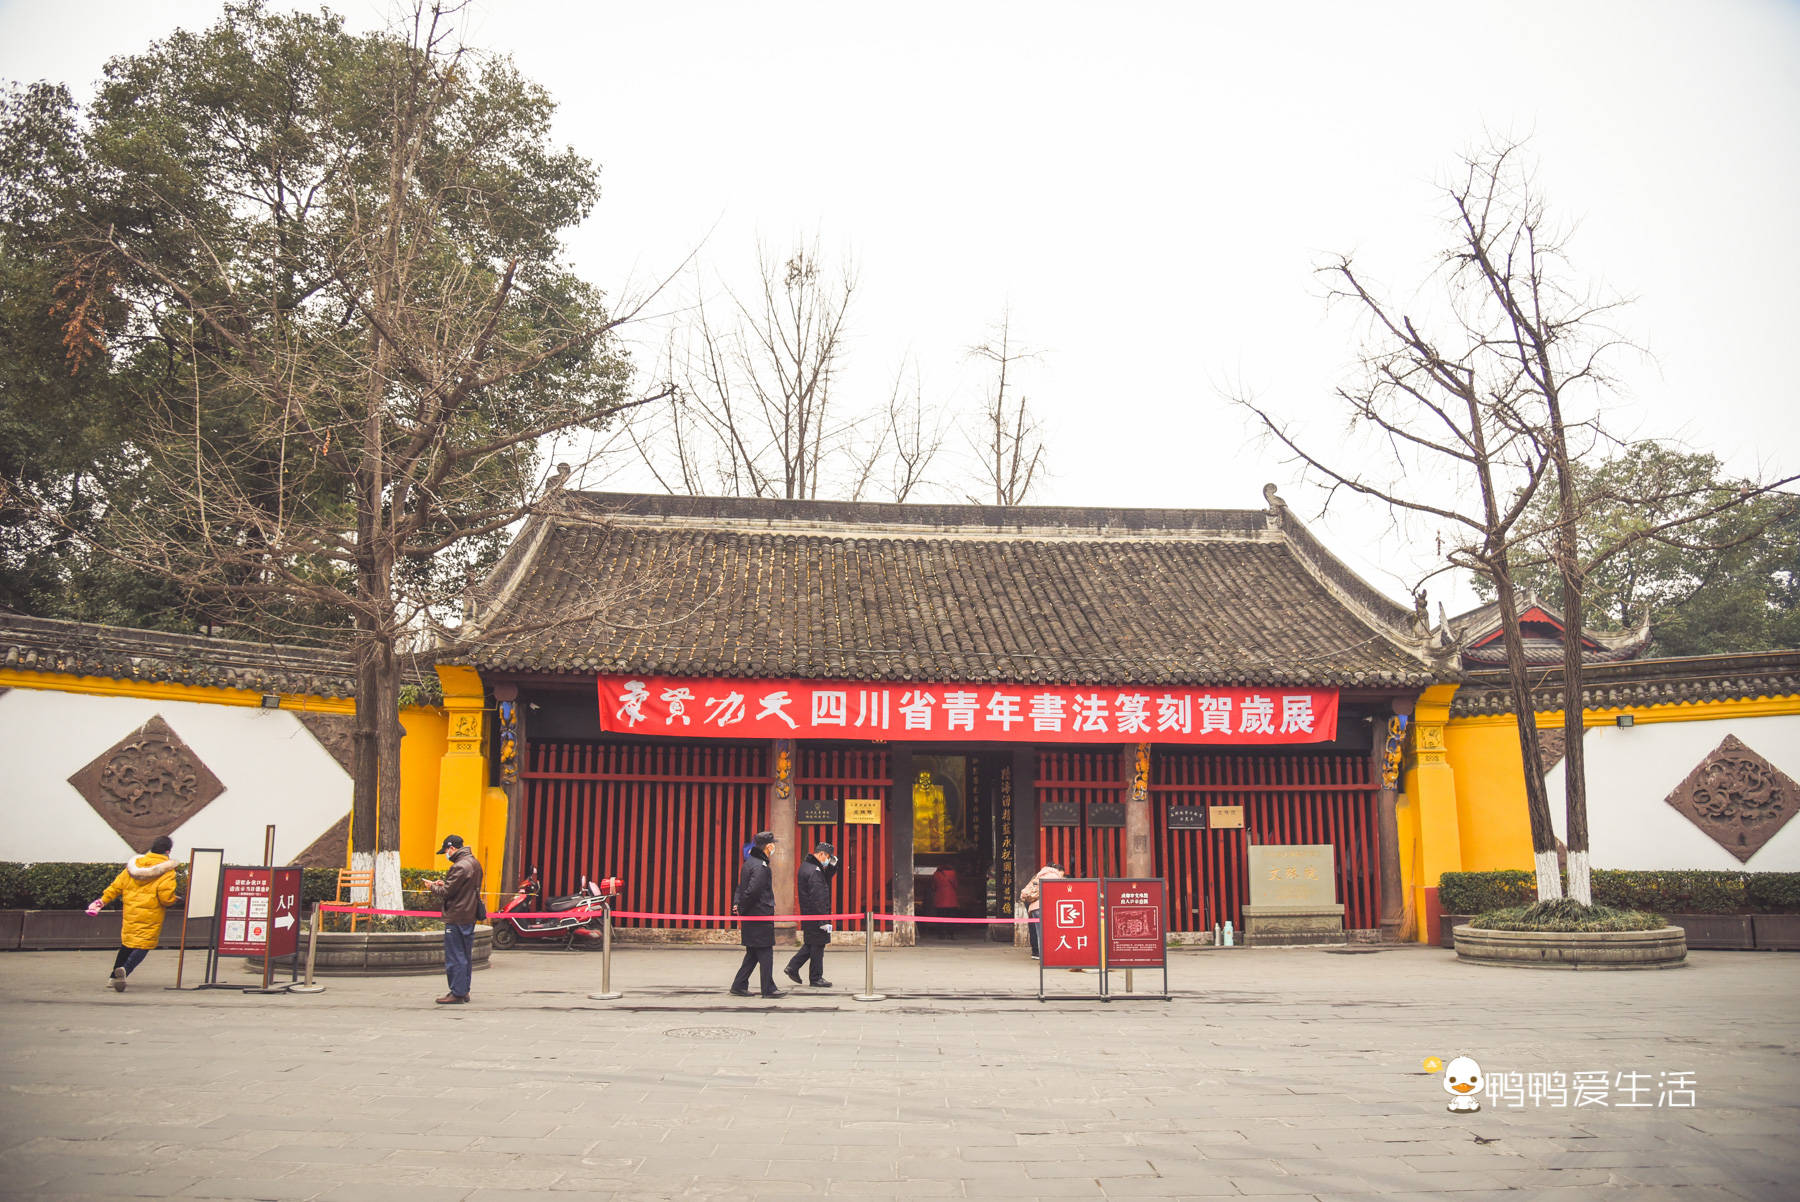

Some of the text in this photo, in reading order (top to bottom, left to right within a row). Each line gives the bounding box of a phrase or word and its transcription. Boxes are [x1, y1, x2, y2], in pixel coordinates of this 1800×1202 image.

[811, 689, 1315, 736] 四川省青年書法篆刻賀歲展
[276, 894, 294, 912] 入口
[1056, 935, 1088, 951] 入口
